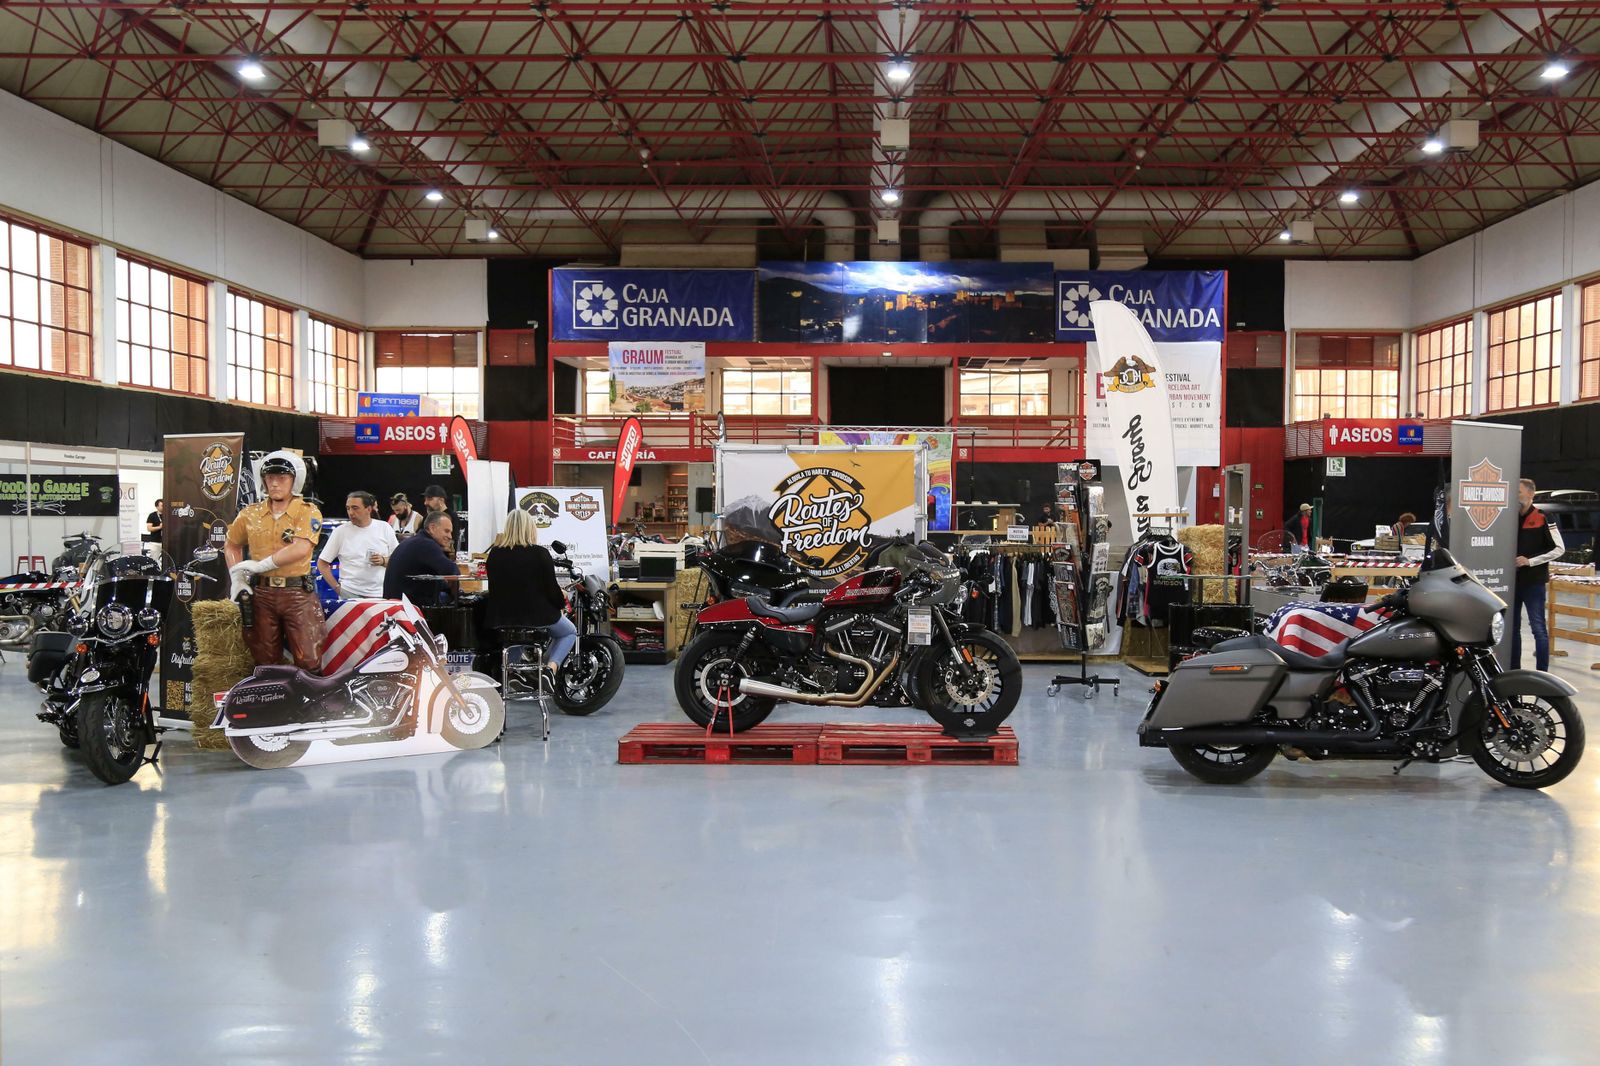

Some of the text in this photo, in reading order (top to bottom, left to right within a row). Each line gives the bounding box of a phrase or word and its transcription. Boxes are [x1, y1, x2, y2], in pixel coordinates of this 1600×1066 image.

[622, 283, 669, 304] CAJA
[1109, 284, 1155, 304] CAJA
[622, 307, 734, 327] GRANADA
[1130, 308, 1220, 328] ANADA
[622, 349, 664, 365] GRAUM
[1165, 373, 1191, 382] ESTIVAL
[384, 425, 436, 441] ASEOS
[1340, 427, 1393, 443] ASEOS
[588, 450, 656, 460] CAFRÍA
[43, 479, 89, 497] GARAGE
[1463, 486, 1505, 501] HARLEY-DAVIDSON
[769, 488, 864, 526] Routes
[822, 517, 833, 527] OF
[781, 519, 872, 554] Freedom
[1471, 536, 1494, 547] GRANADA
[447, 654, 469, 663] OUTE
